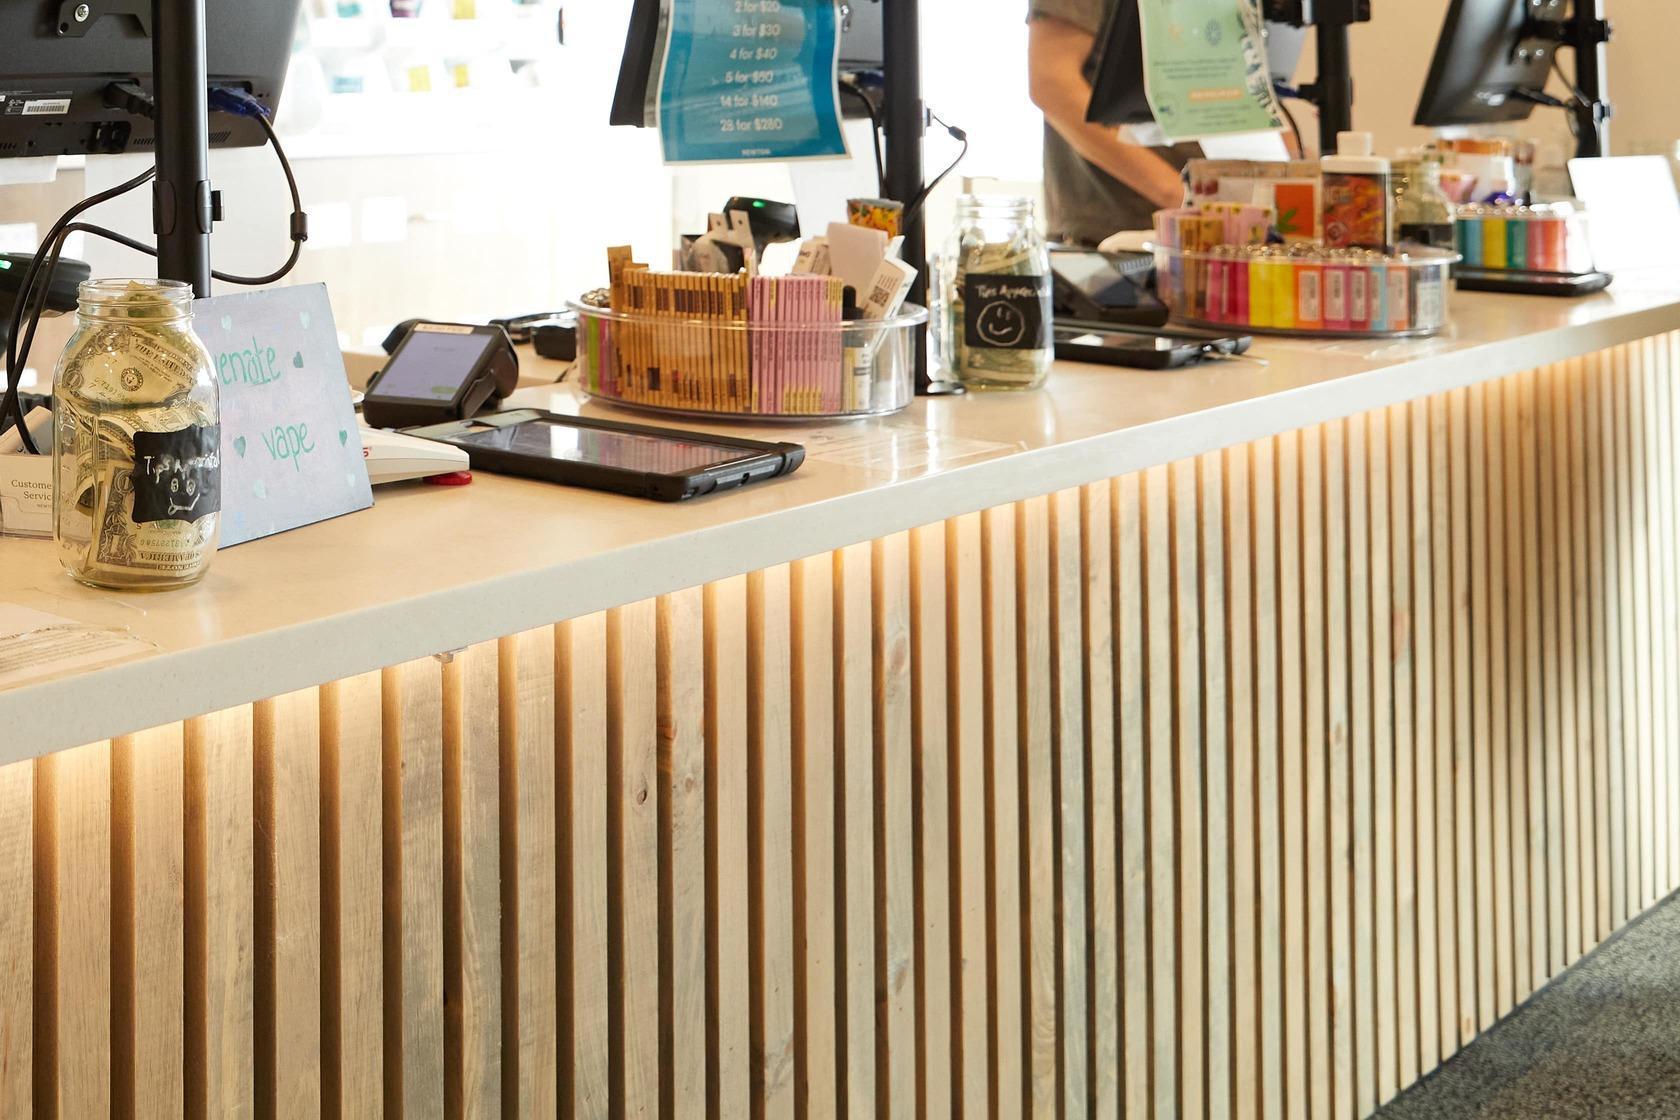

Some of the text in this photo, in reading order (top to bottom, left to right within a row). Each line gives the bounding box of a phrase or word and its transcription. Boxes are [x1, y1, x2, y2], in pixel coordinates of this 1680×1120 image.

[729, 48, 737, 60] 4
[214, 335, 281, 386] enate
[262, 423, 315, 473] vape
[11, 479, 53, 490] Custome
[23, 491, 53, 501] Servic
